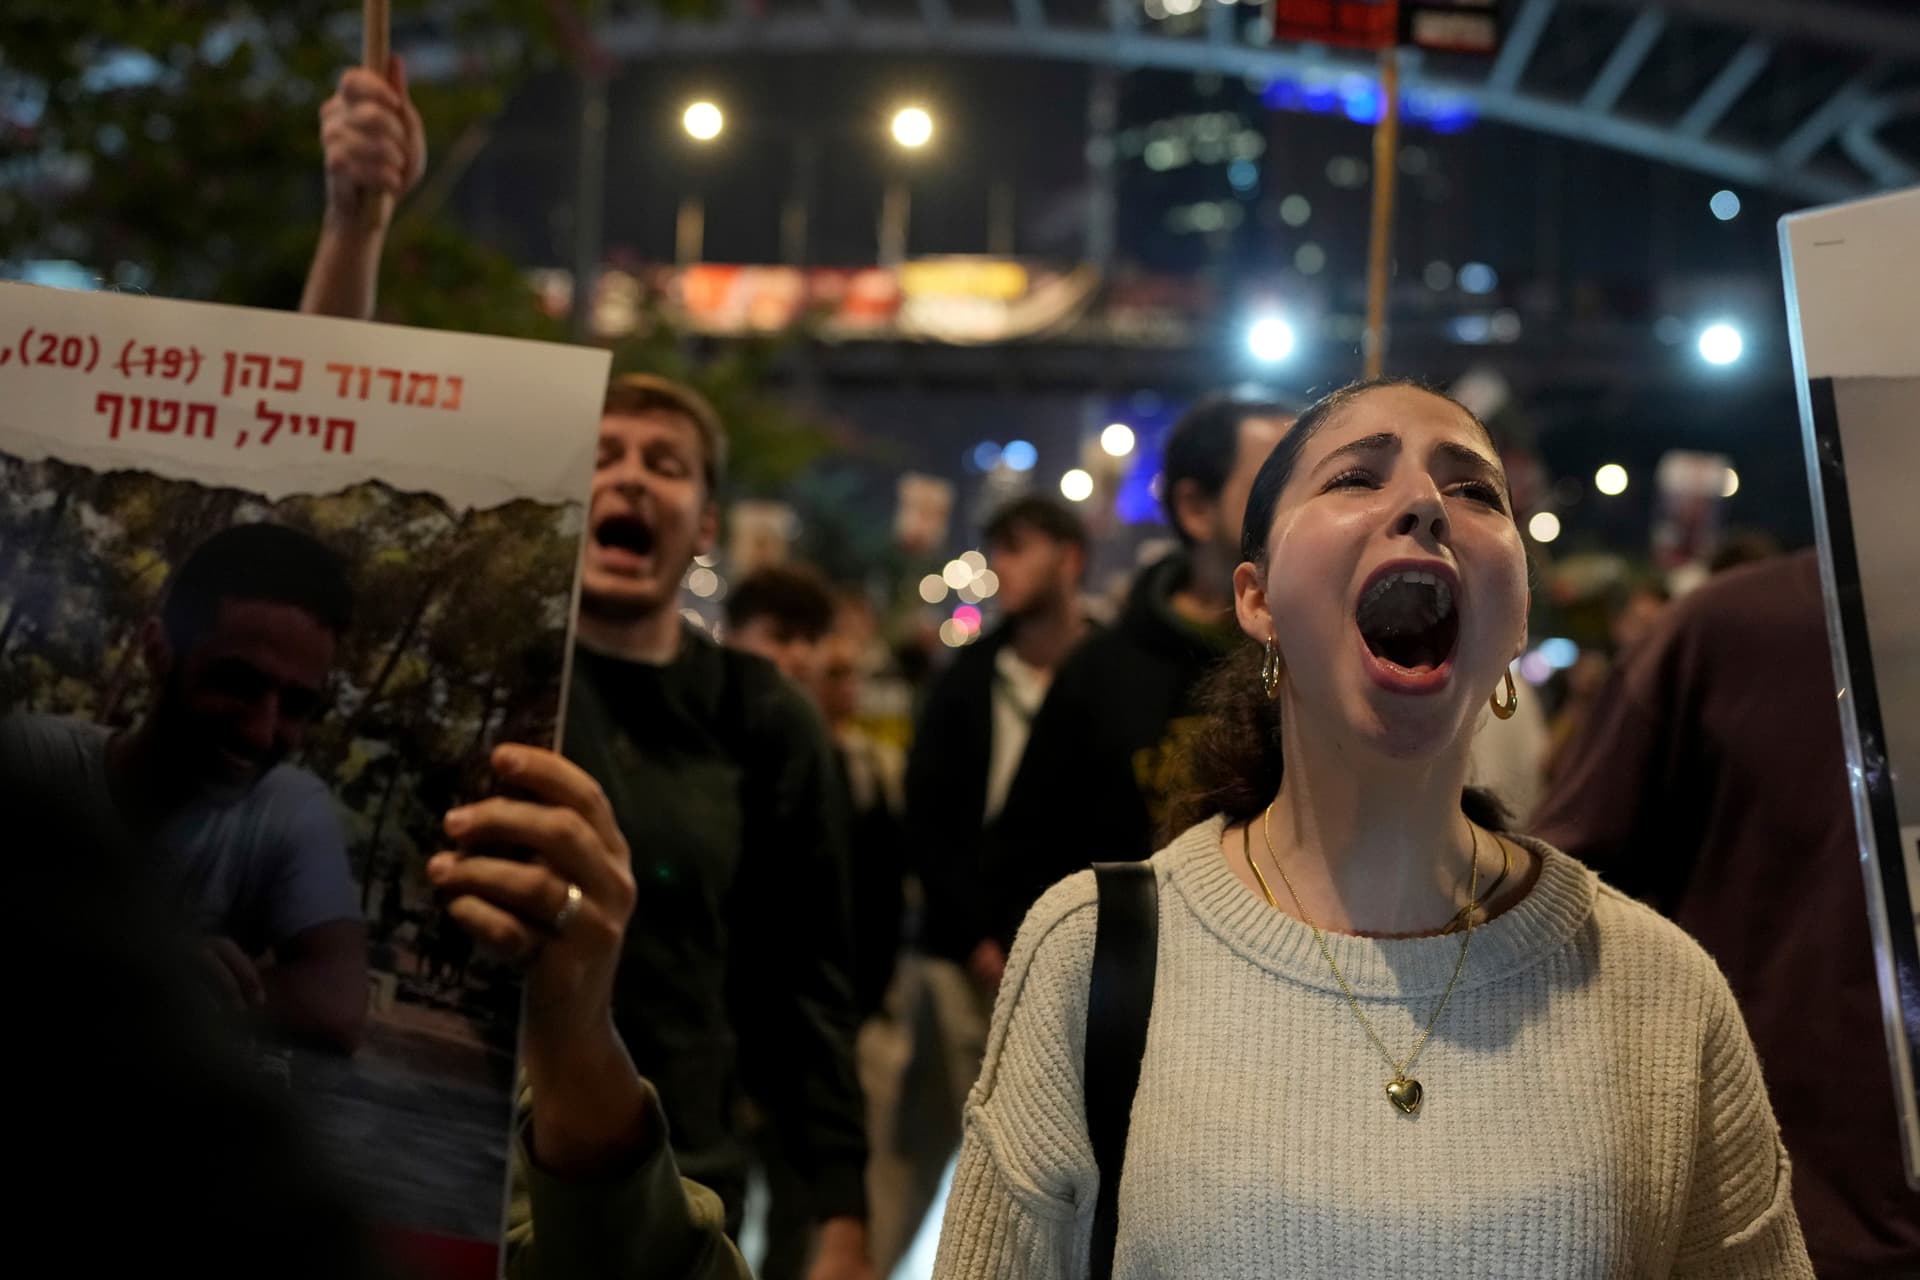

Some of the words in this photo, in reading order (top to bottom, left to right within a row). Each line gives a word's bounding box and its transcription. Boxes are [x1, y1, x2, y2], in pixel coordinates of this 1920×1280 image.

[222, 350, 304, 396] כהן
[325, 362, 464, 410] נמרוד
[95, 391, 217, 439] חטוף
[234, 400, 357, 454] חייל,
